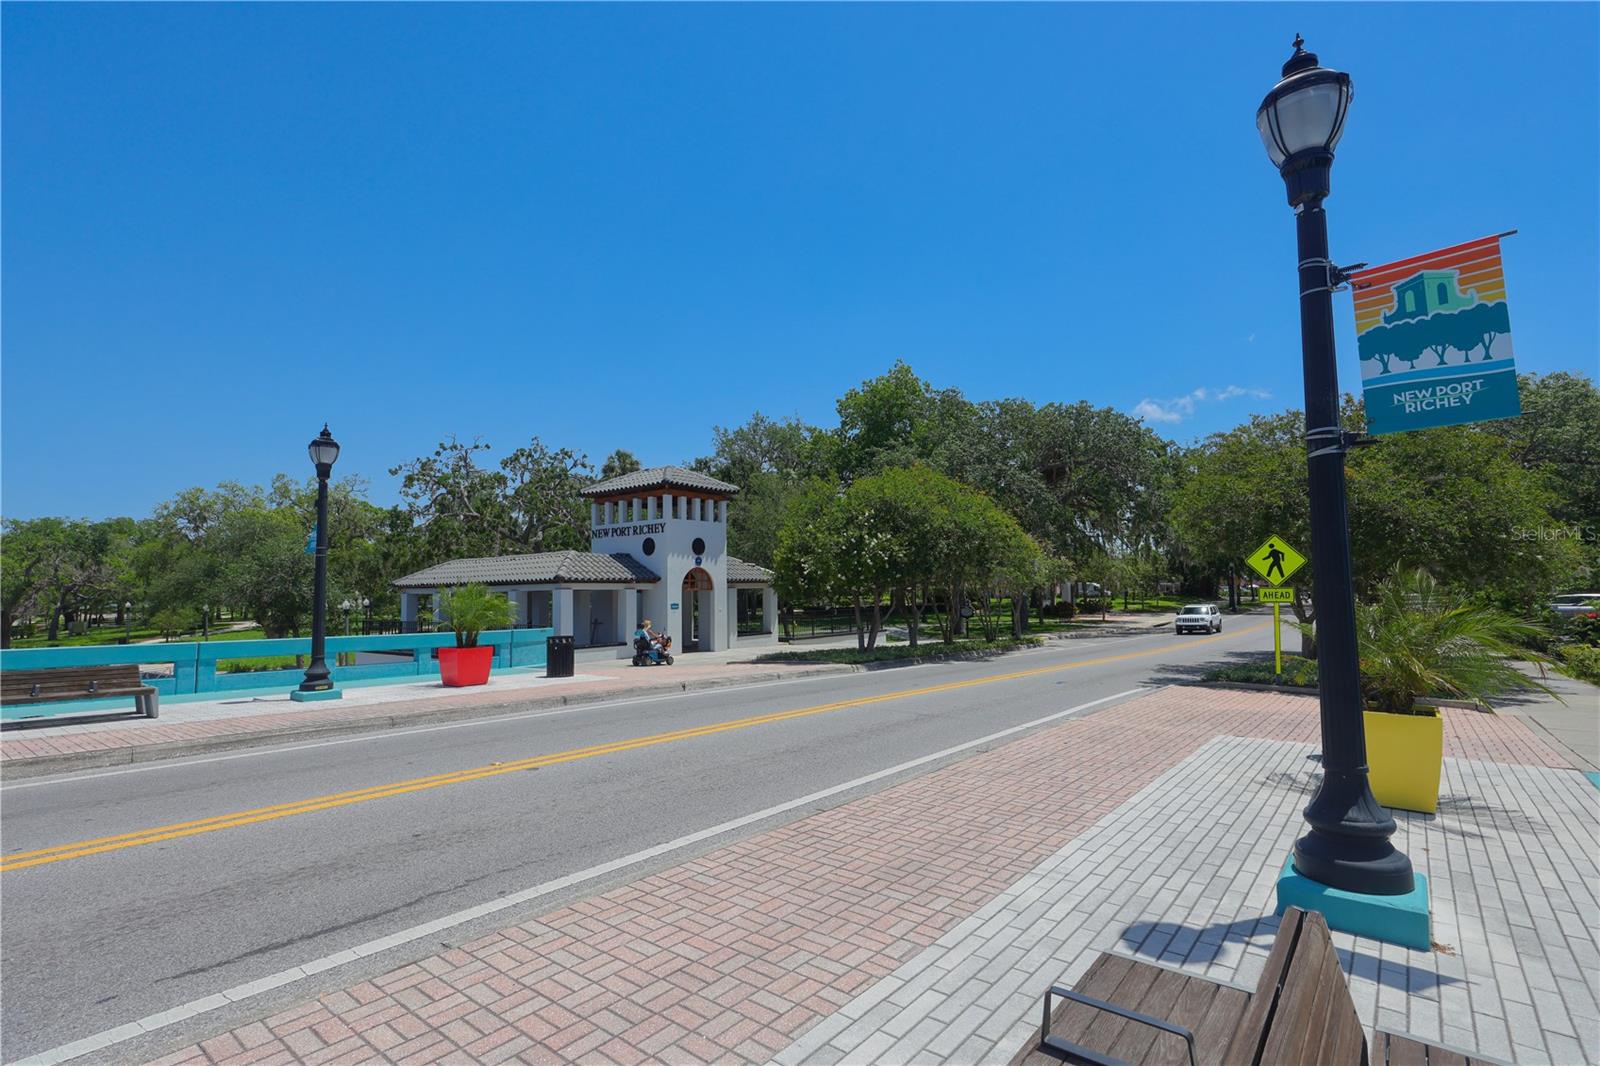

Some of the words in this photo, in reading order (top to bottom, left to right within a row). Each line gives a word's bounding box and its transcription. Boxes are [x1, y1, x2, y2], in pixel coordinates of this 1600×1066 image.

[1393, 387, 1432, 405] NEW
[1435, 379, 1484, 397] PORT
[1405, 393, 1473, 413] RICHEY
[592, 528, 611, 539] NEW
[611, 526, 632, 538] PORT
[632, 522, 666, 536] RICHEY
[1263, 591, 1291, 599] AHEAD
